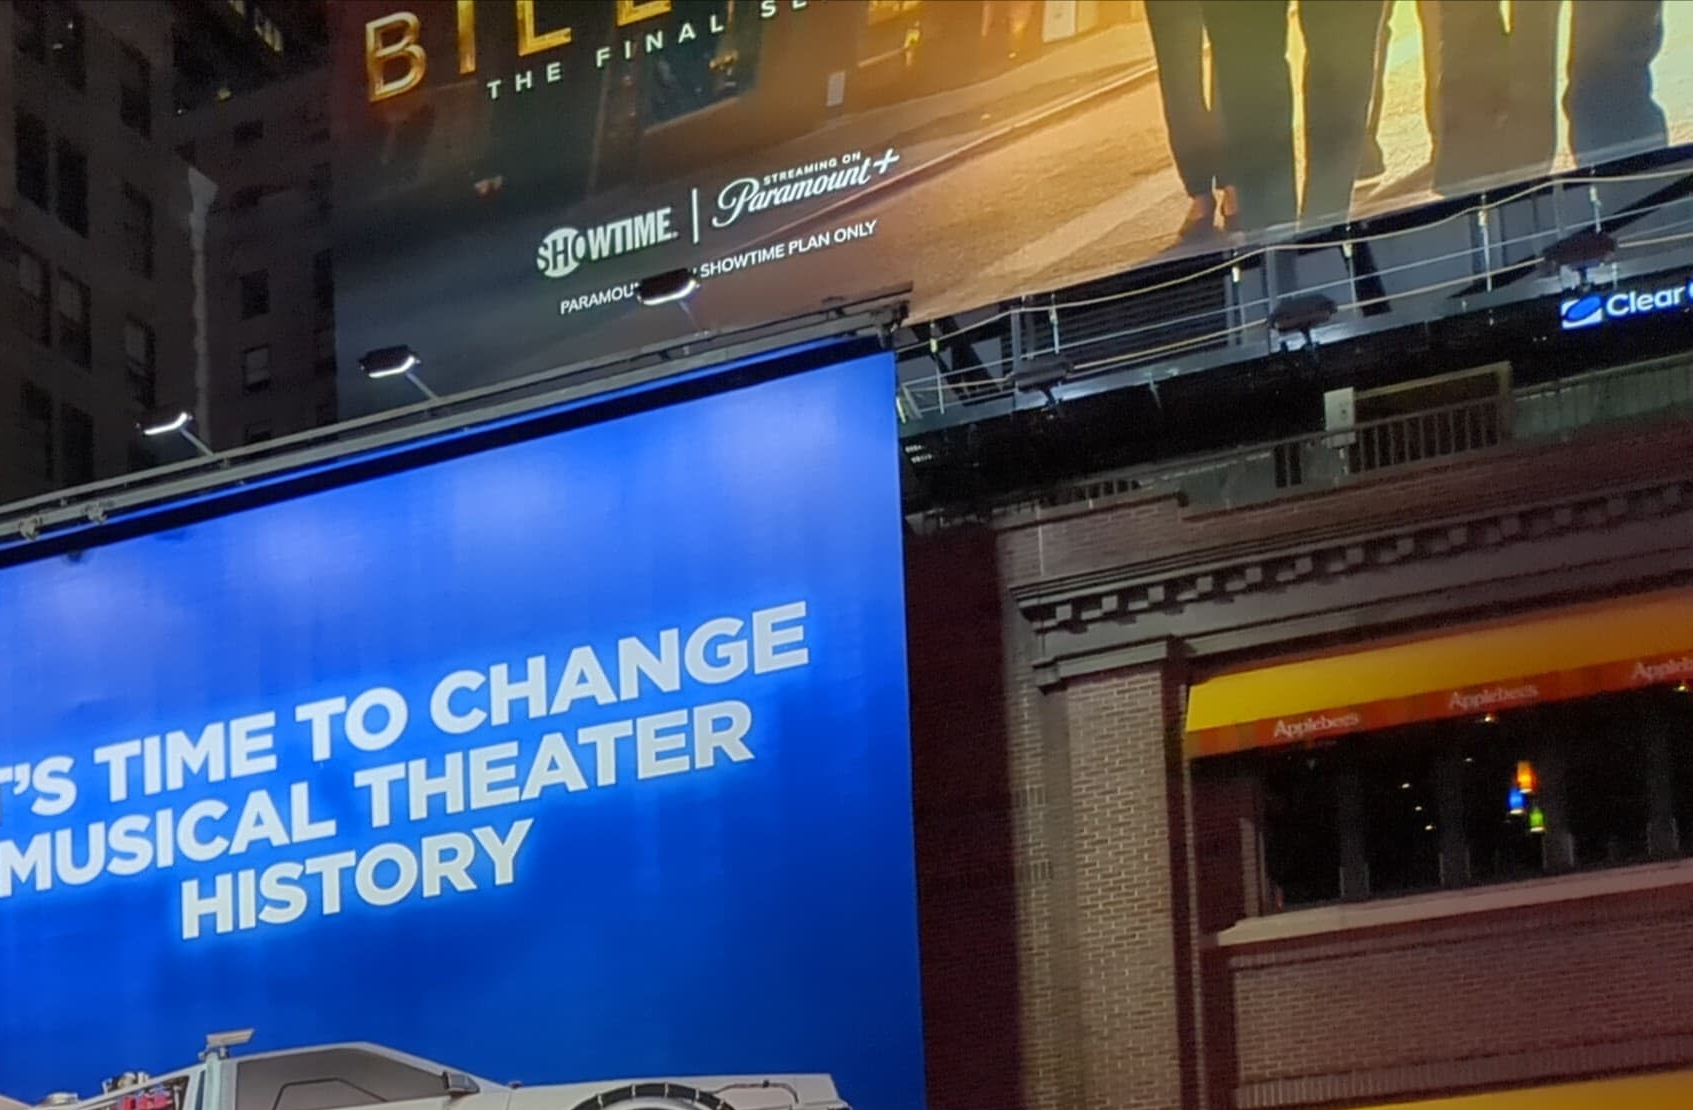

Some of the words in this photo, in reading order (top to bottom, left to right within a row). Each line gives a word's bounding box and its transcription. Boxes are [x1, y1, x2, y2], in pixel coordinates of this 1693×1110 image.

[486, 61, 563, 99] THE
[596, 13, 724, 68] FINAL
[712, 148, 900, 228] Paramount+
[763, 155, 837, 186] STREAMING
[841, 151, 862, 165] ON
[537, 207, 680, 278] SHOWTIME
[700, 243, 785, 279] SHOWTIME
[788, 233, 831, 256] PLAN
[834, 219, 877, 242] ONLY
[1606, 286, 1686, 316] Clear
[94, 712, 278, 802] TIME
[296, 686, 408, 763] TO
[430, 601, 810, 733] CHANGE
[354, 699, 755, 828] THEATER
[179, 818, 534, 941] HISTORY
